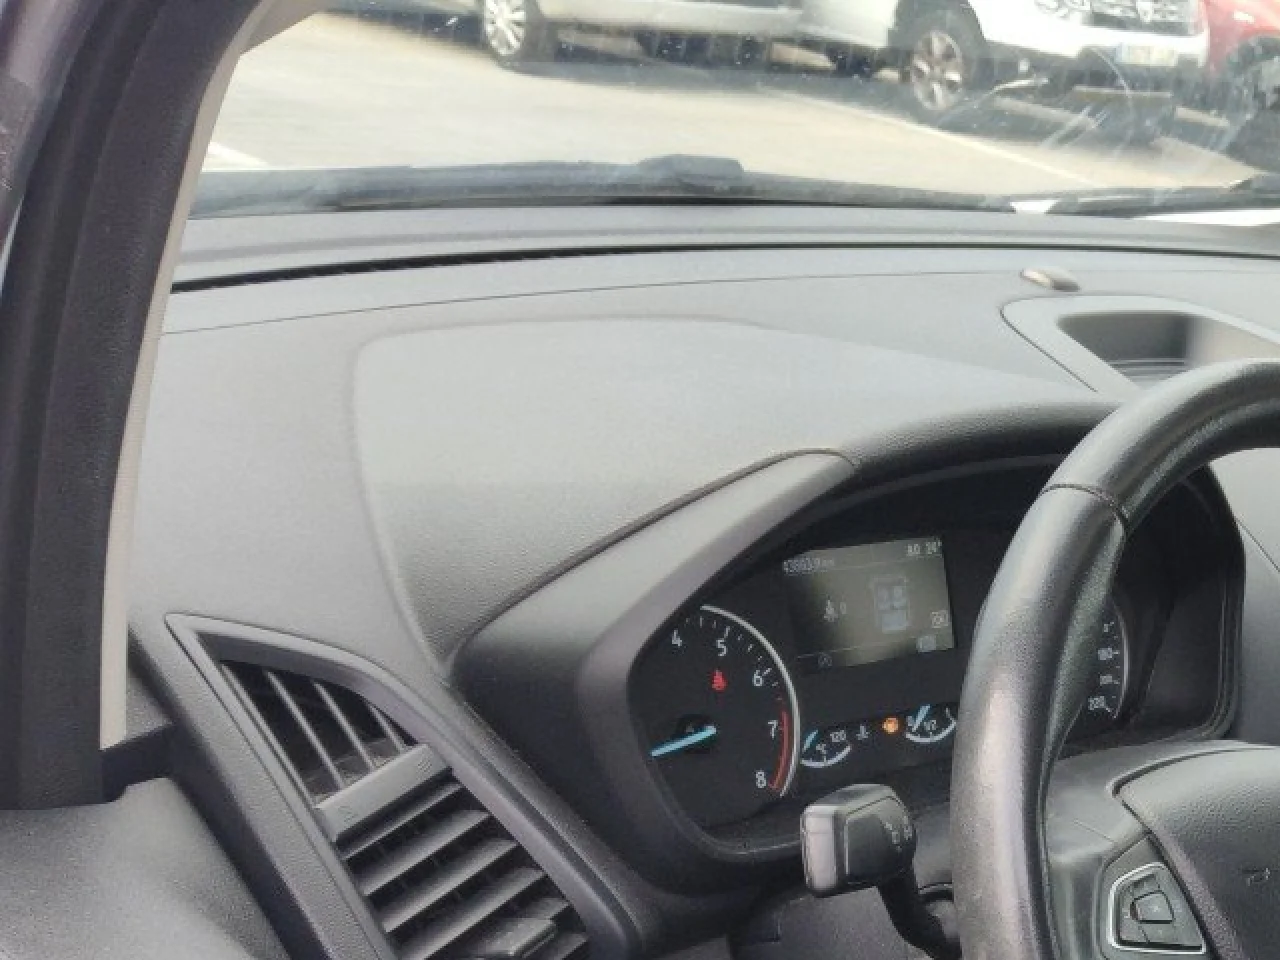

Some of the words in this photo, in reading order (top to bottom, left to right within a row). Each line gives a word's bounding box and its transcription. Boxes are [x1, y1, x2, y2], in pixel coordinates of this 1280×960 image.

[671, 629, 683, 647] 4
[716, 638, 727, 657] 5
[752, 669, 763, 687] 6
[767, 719, 779, 739] 7
[755, 769, 767, 789] 8
